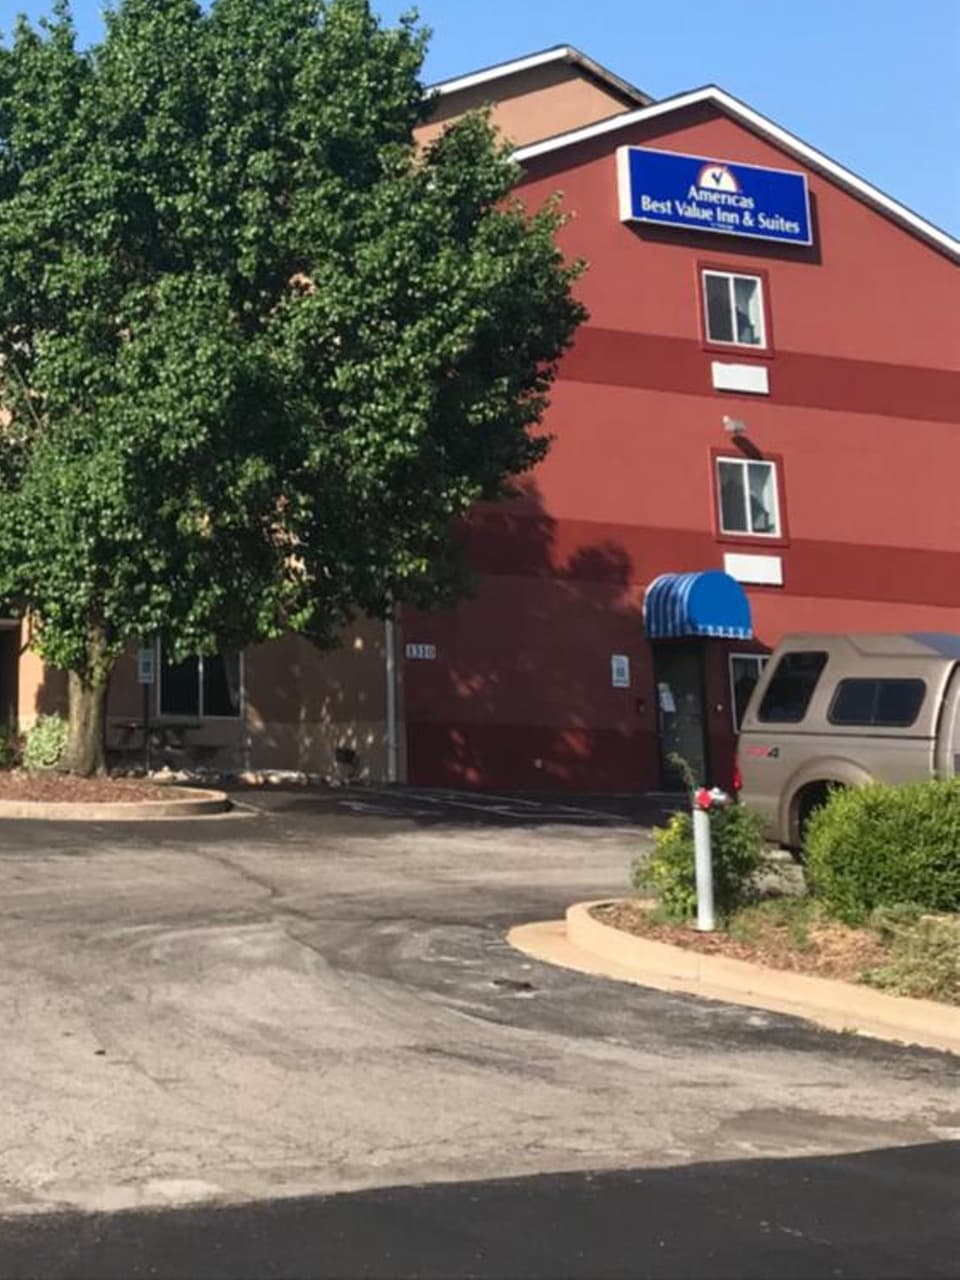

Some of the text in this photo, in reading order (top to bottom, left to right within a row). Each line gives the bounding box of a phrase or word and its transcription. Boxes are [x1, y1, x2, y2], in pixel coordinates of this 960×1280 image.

[687, 184, 755, 209] Americas
[641, 194, 800, 234] Best Value Inn & Suites
